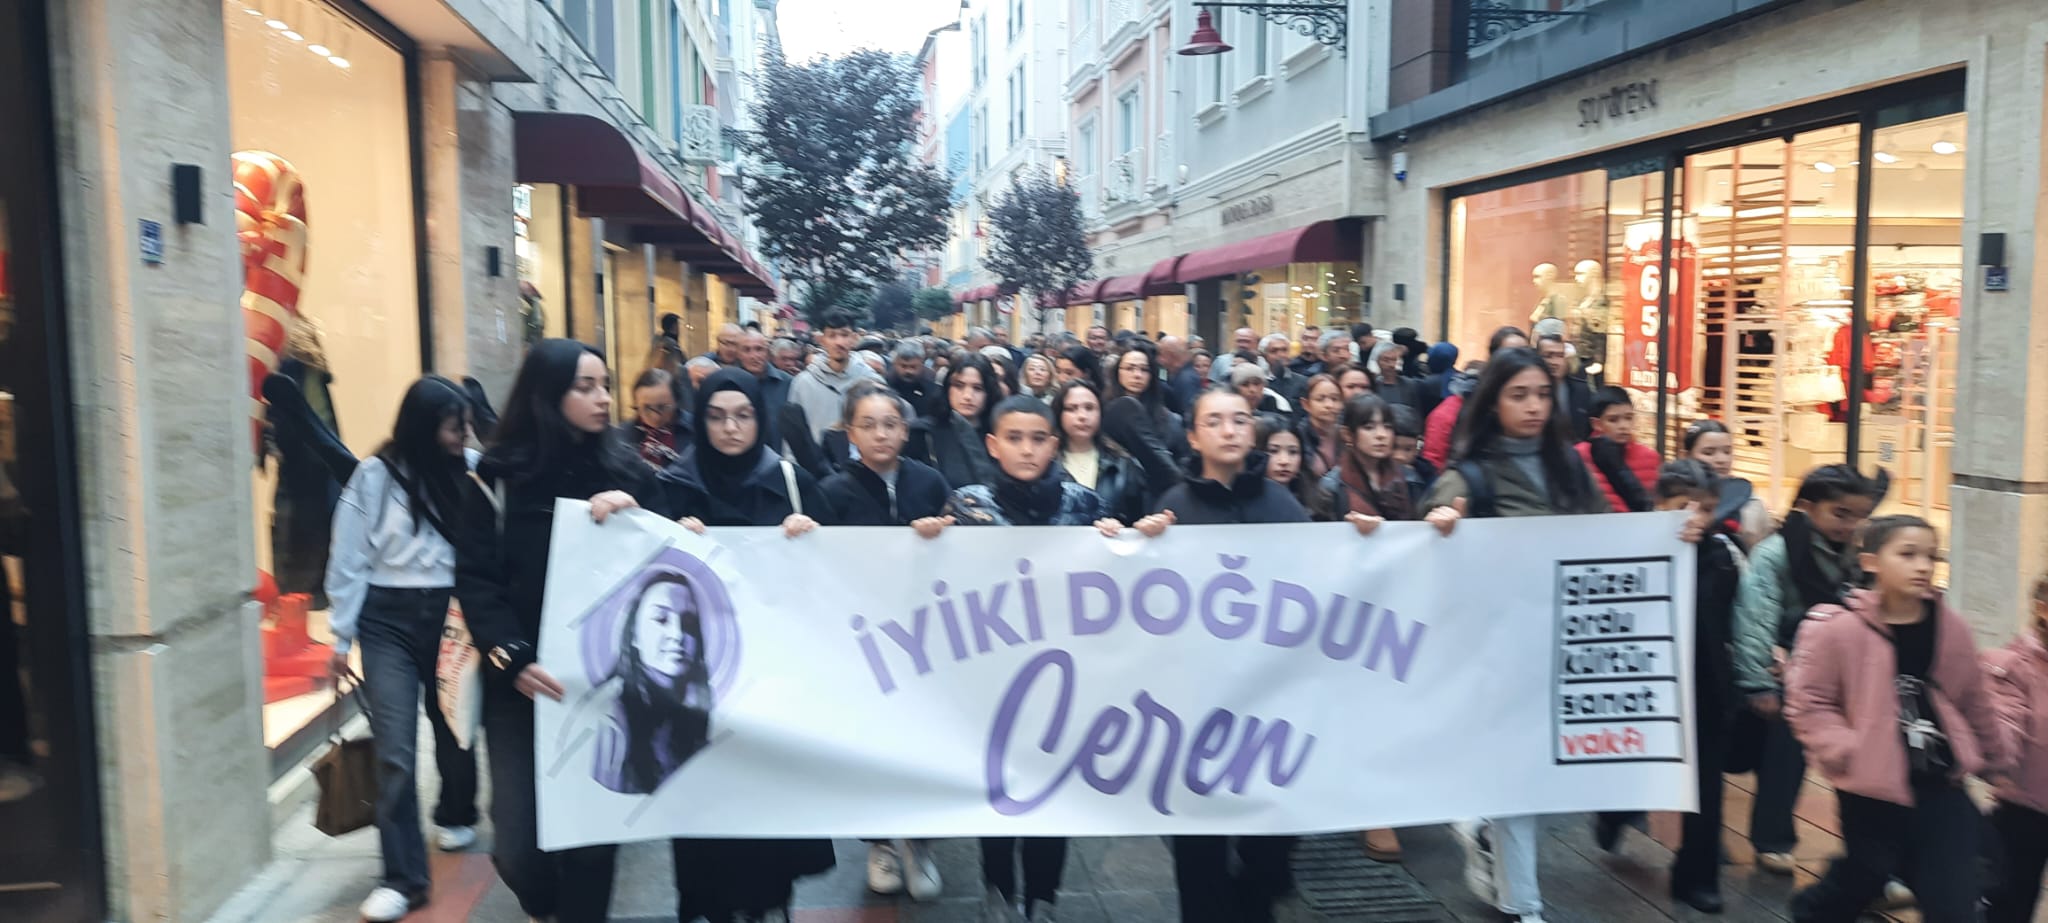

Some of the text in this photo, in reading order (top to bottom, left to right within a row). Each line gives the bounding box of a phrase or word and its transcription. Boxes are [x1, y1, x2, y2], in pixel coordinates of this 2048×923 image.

[1561, 566, 1647, 605] güzel
[850, 553, 1428, 695] İYİKİ DOĞDUN
[1561, 607, 1634, 636] ordu
[1559, 645, 1658, 674] kültür
[1560, 686, 1658, 715] sanat
[985, 648, 1317, 816] Ceren
[1561, 726, 1645, 755] vakfı
